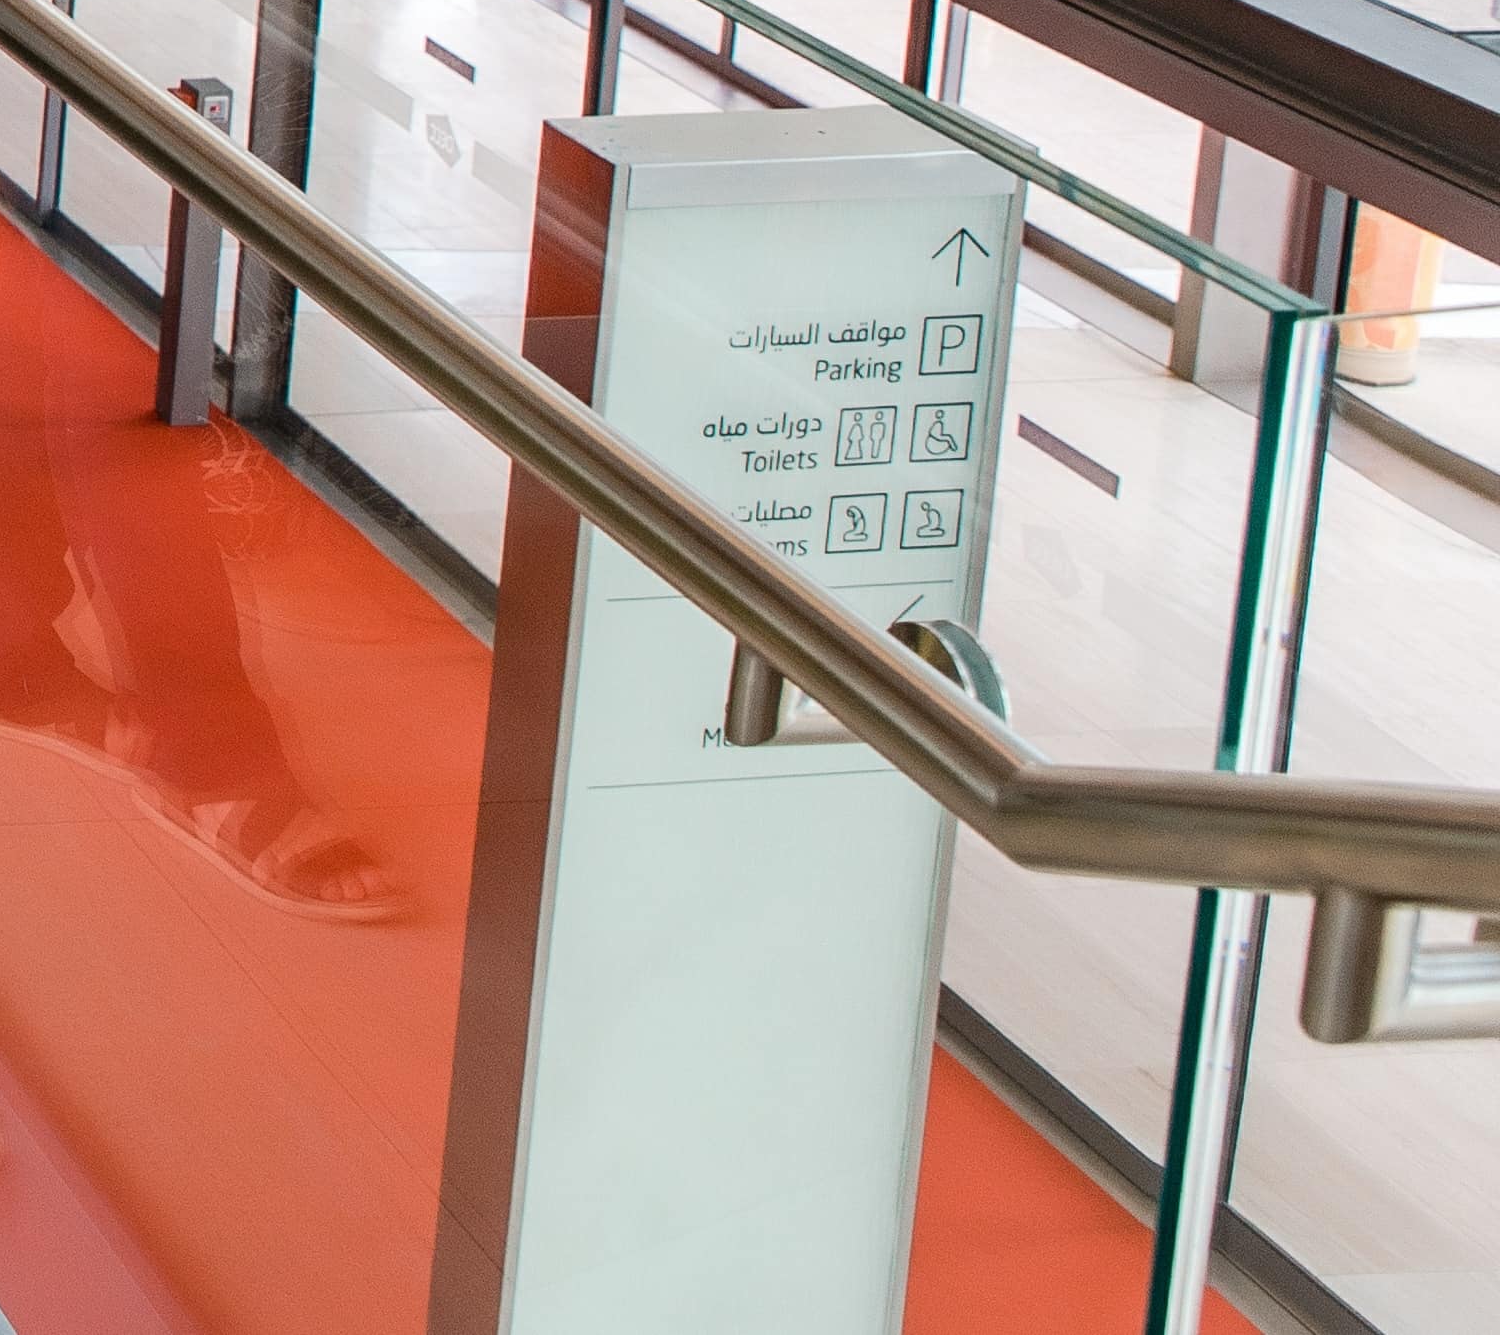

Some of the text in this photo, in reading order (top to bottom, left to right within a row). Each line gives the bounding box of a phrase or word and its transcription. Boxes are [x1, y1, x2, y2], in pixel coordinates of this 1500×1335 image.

[729, 320, 906, 353] مواقف السيارات
[939, 324, 966, 367] P
[814, 357, 902, 383] Parking
[702, 412, 822, 443] دورات مياه
[741, 450, 818, 473] Toilets
[731, 500, 812, 527] مصليات
